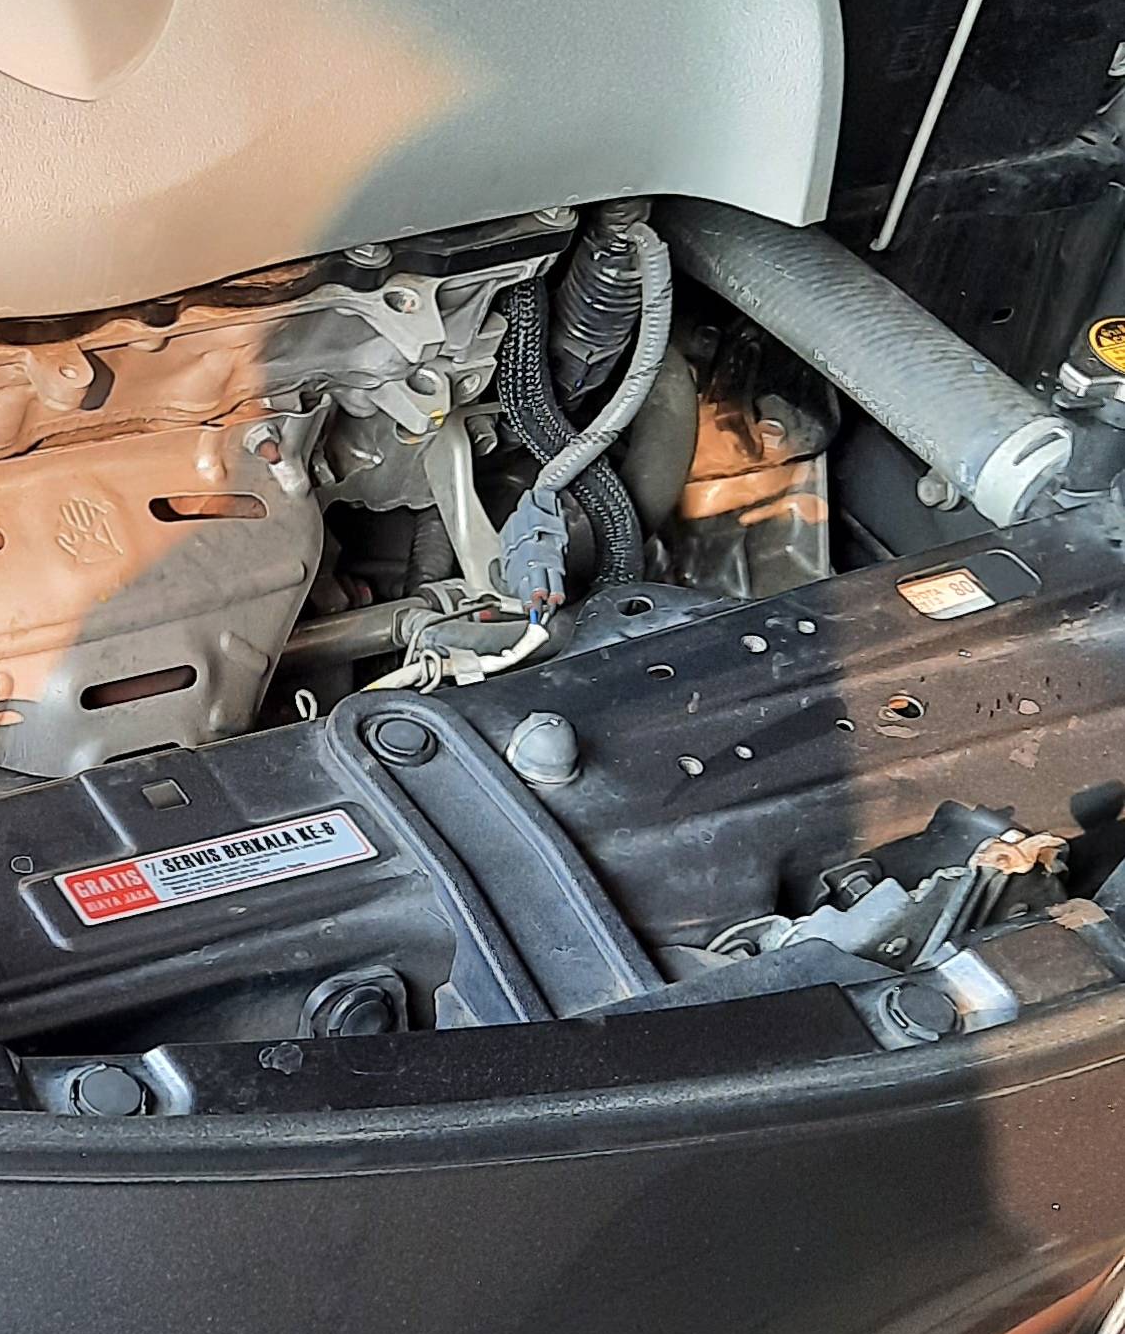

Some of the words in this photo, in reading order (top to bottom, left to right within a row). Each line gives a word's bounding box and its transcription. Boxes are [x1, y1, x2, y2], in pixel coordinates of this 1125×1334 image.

[161, 848, 222, 873] SERVIS
[220, 831, 298, 859] BERKALA
[72, 869, 143, 898] GRATIS
